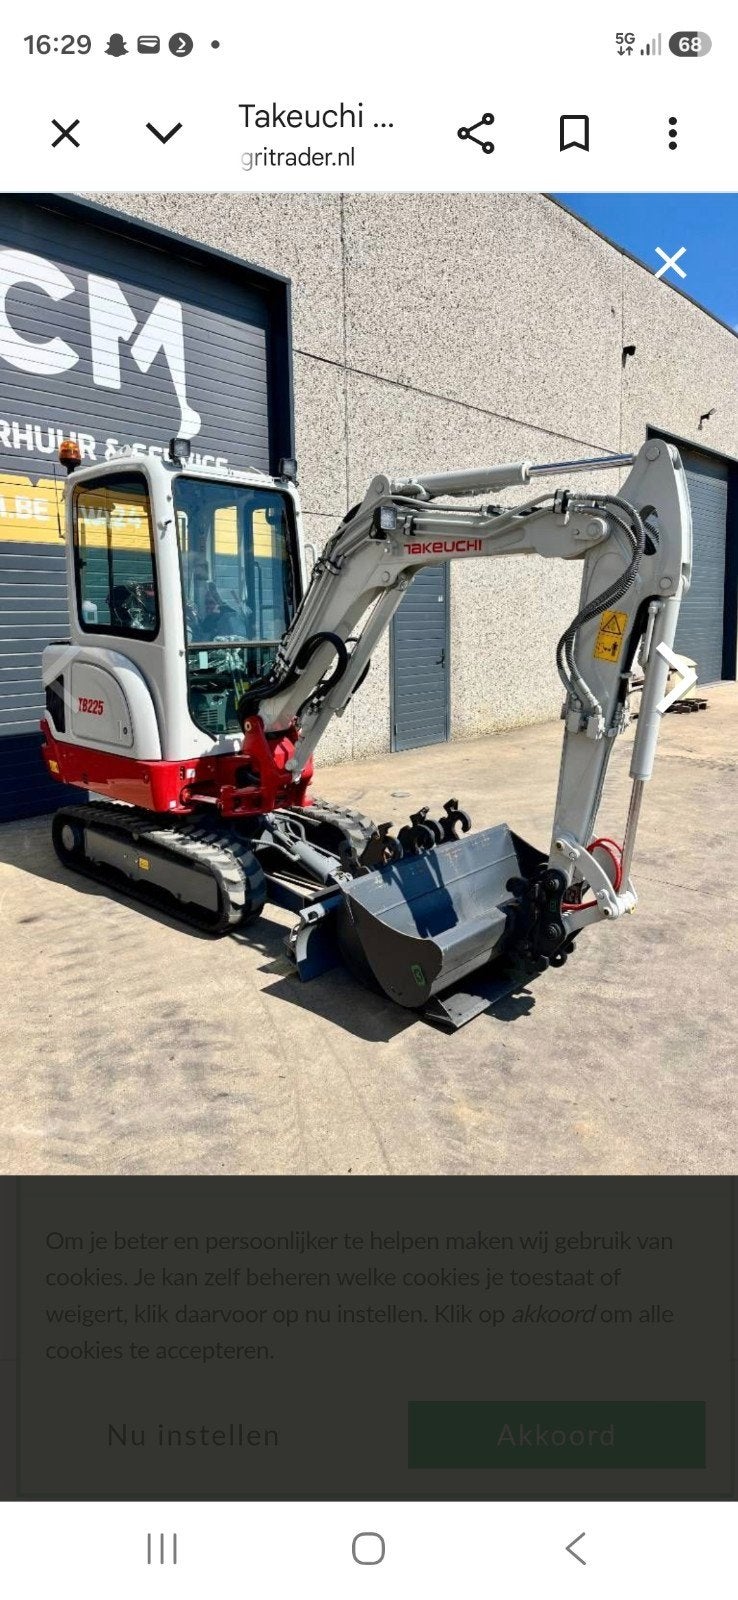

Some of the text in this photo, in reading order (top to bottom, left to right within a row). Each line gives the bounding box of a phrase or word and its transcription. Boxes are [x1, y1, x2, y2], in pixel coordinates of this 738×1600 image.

[23, 34, 92, 56] 16:29
[615, 32, 636, 45] 5G
[678, 36, 702, 53] 68
[238, 102, 364, 129] Takeuchi
[240, 144, 355, 172] gritrader.nl
[78, 697, 104, 716] TB225
[46, 1231, 673, 1255] Om je beter en persoonlijker te helpen maken wij gebruik van
[46, 1267, 622, 1291] cookies. Je kan zelf beheren welke cookies je toestaat of
[46, 1304, 674, 1328] weigert, klik daarvoor op nu instellen. Klik op akkoord om alle
[46, 1340, 274, 1364] cookies te accepteren.
[107, 1423, 279, 1447] Nu instellen
[497, 1423, 615, 1447] Akkoord
